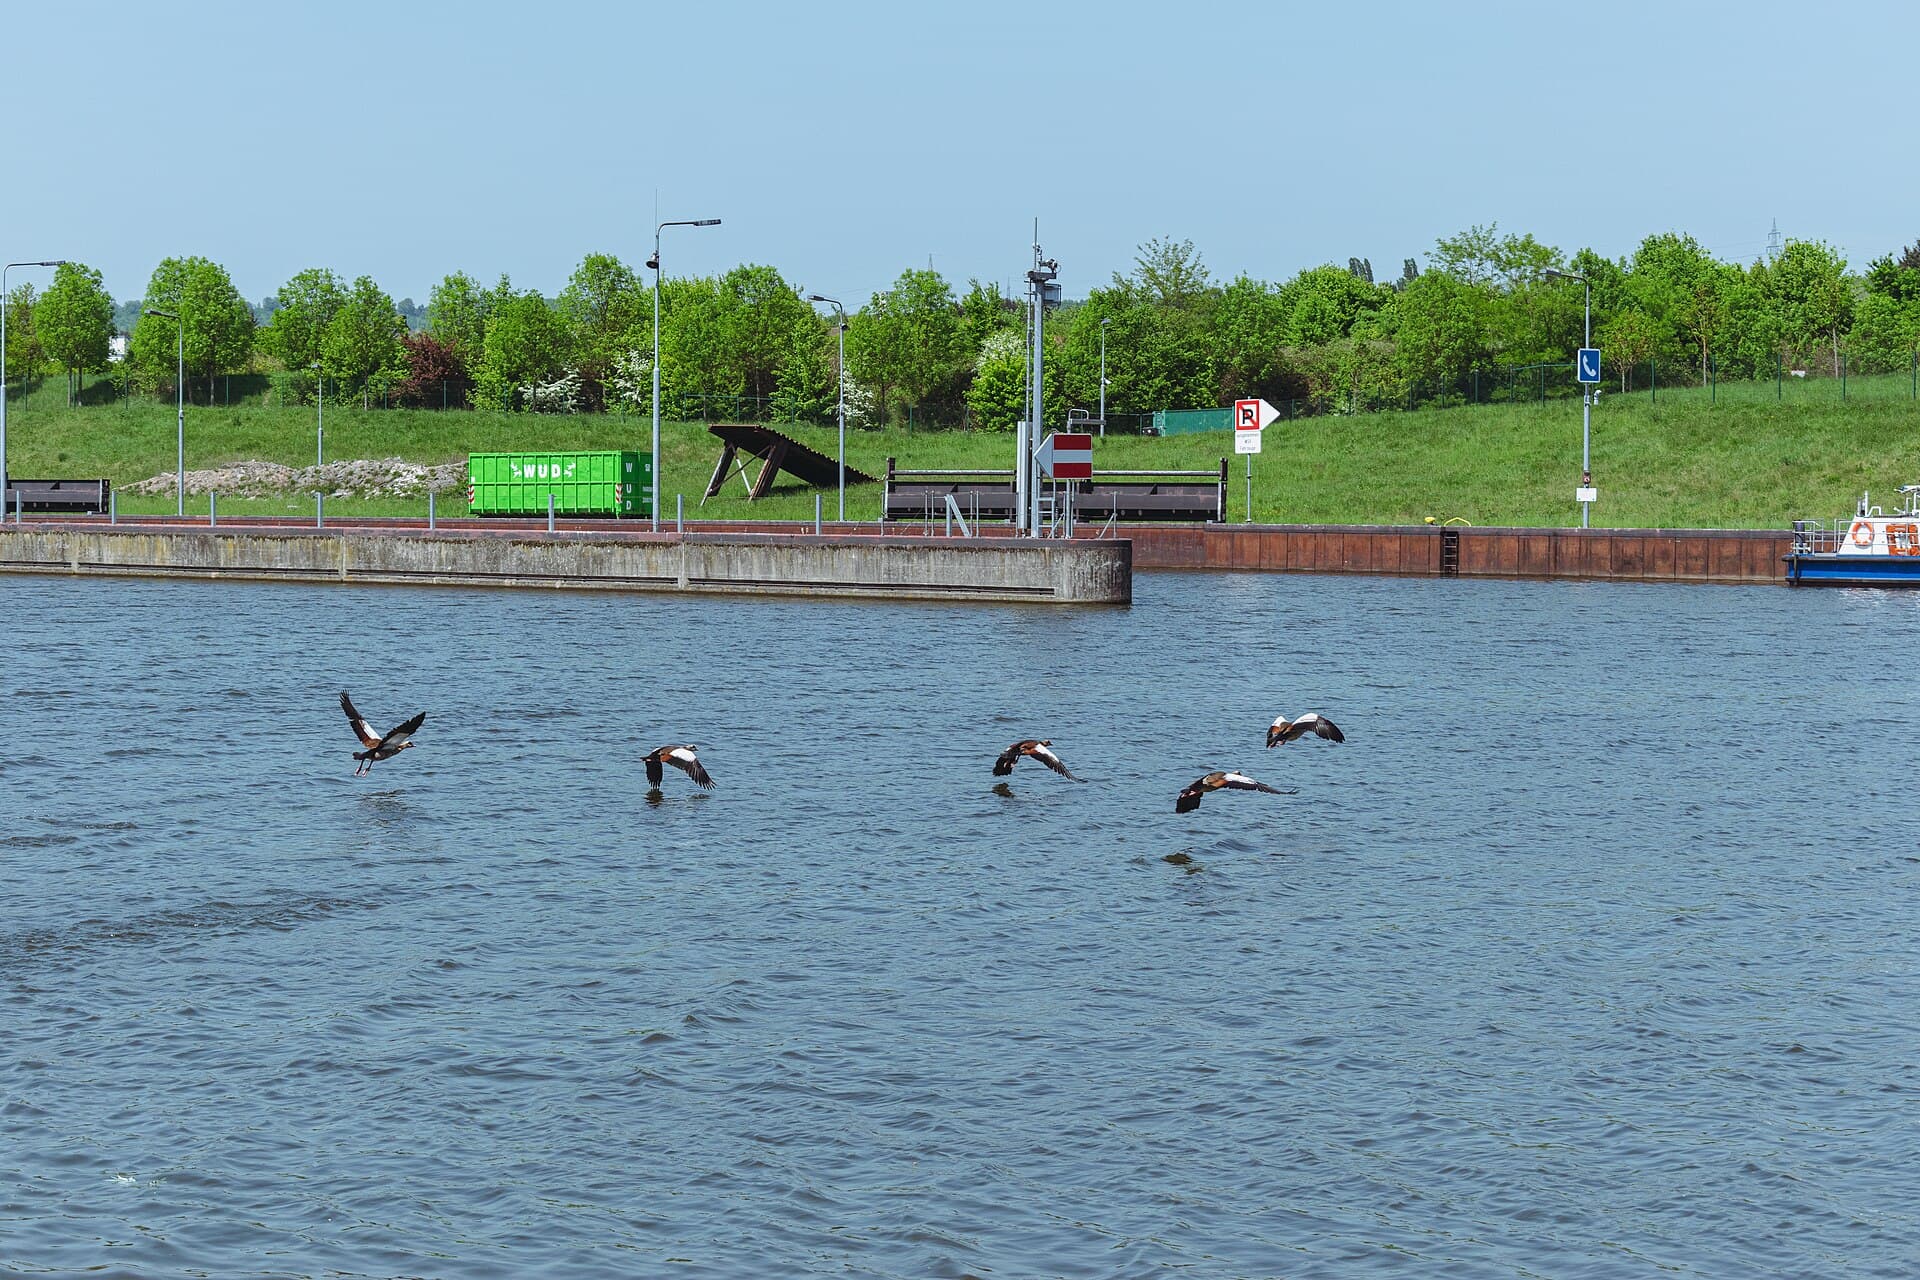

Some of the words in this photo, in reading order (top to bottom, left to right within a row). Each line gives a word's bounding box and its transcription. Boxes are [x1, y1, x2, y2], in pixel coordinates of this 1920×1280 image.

[1242, 409, 1253, 424] P
[523, 463, 561, 478] WUD
[625, 462, 633, 510] WUD
